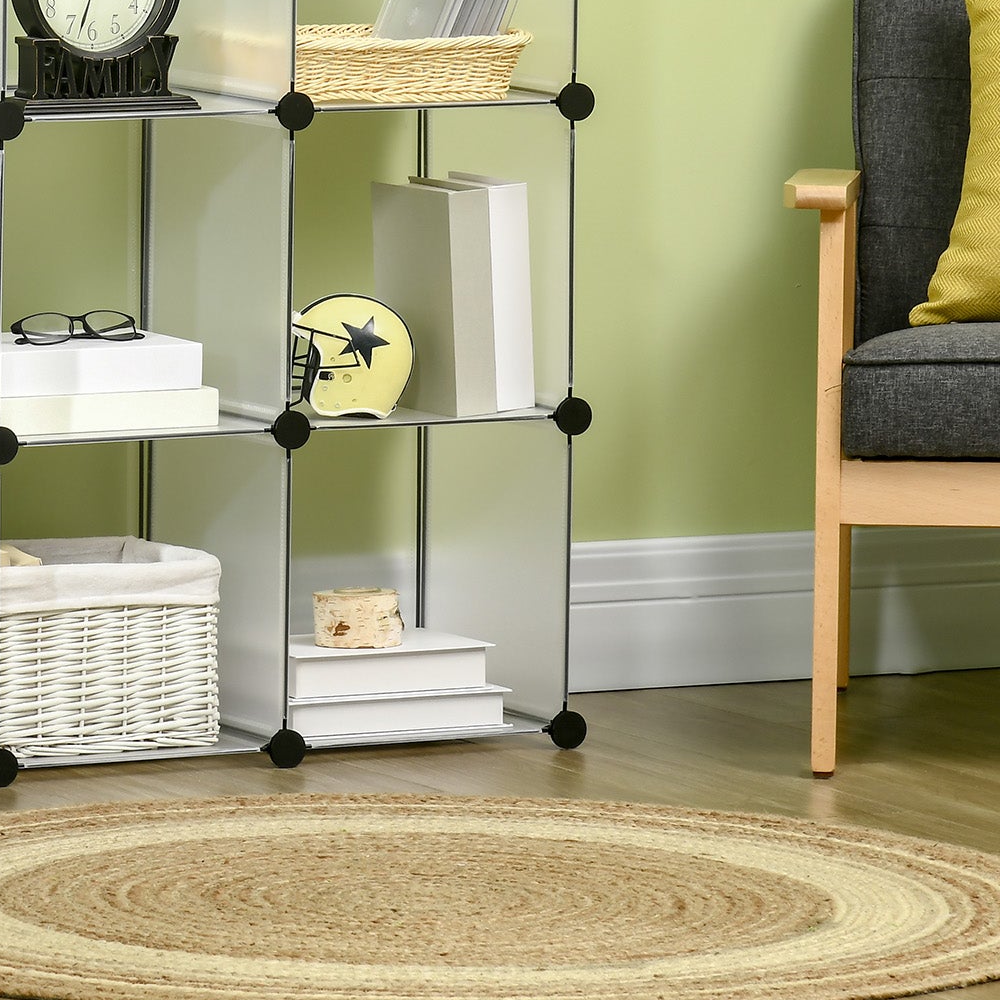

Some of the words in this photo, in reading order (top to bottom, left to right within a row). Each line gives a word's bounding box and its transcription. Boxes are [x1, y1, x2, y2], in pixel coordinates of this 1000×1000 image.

[65, 15, 77, 35] 7
[87, 21, 97, 41] 6
[110, 14, 120, 34] 5
[32, 35, 179, 99] FAMILY
